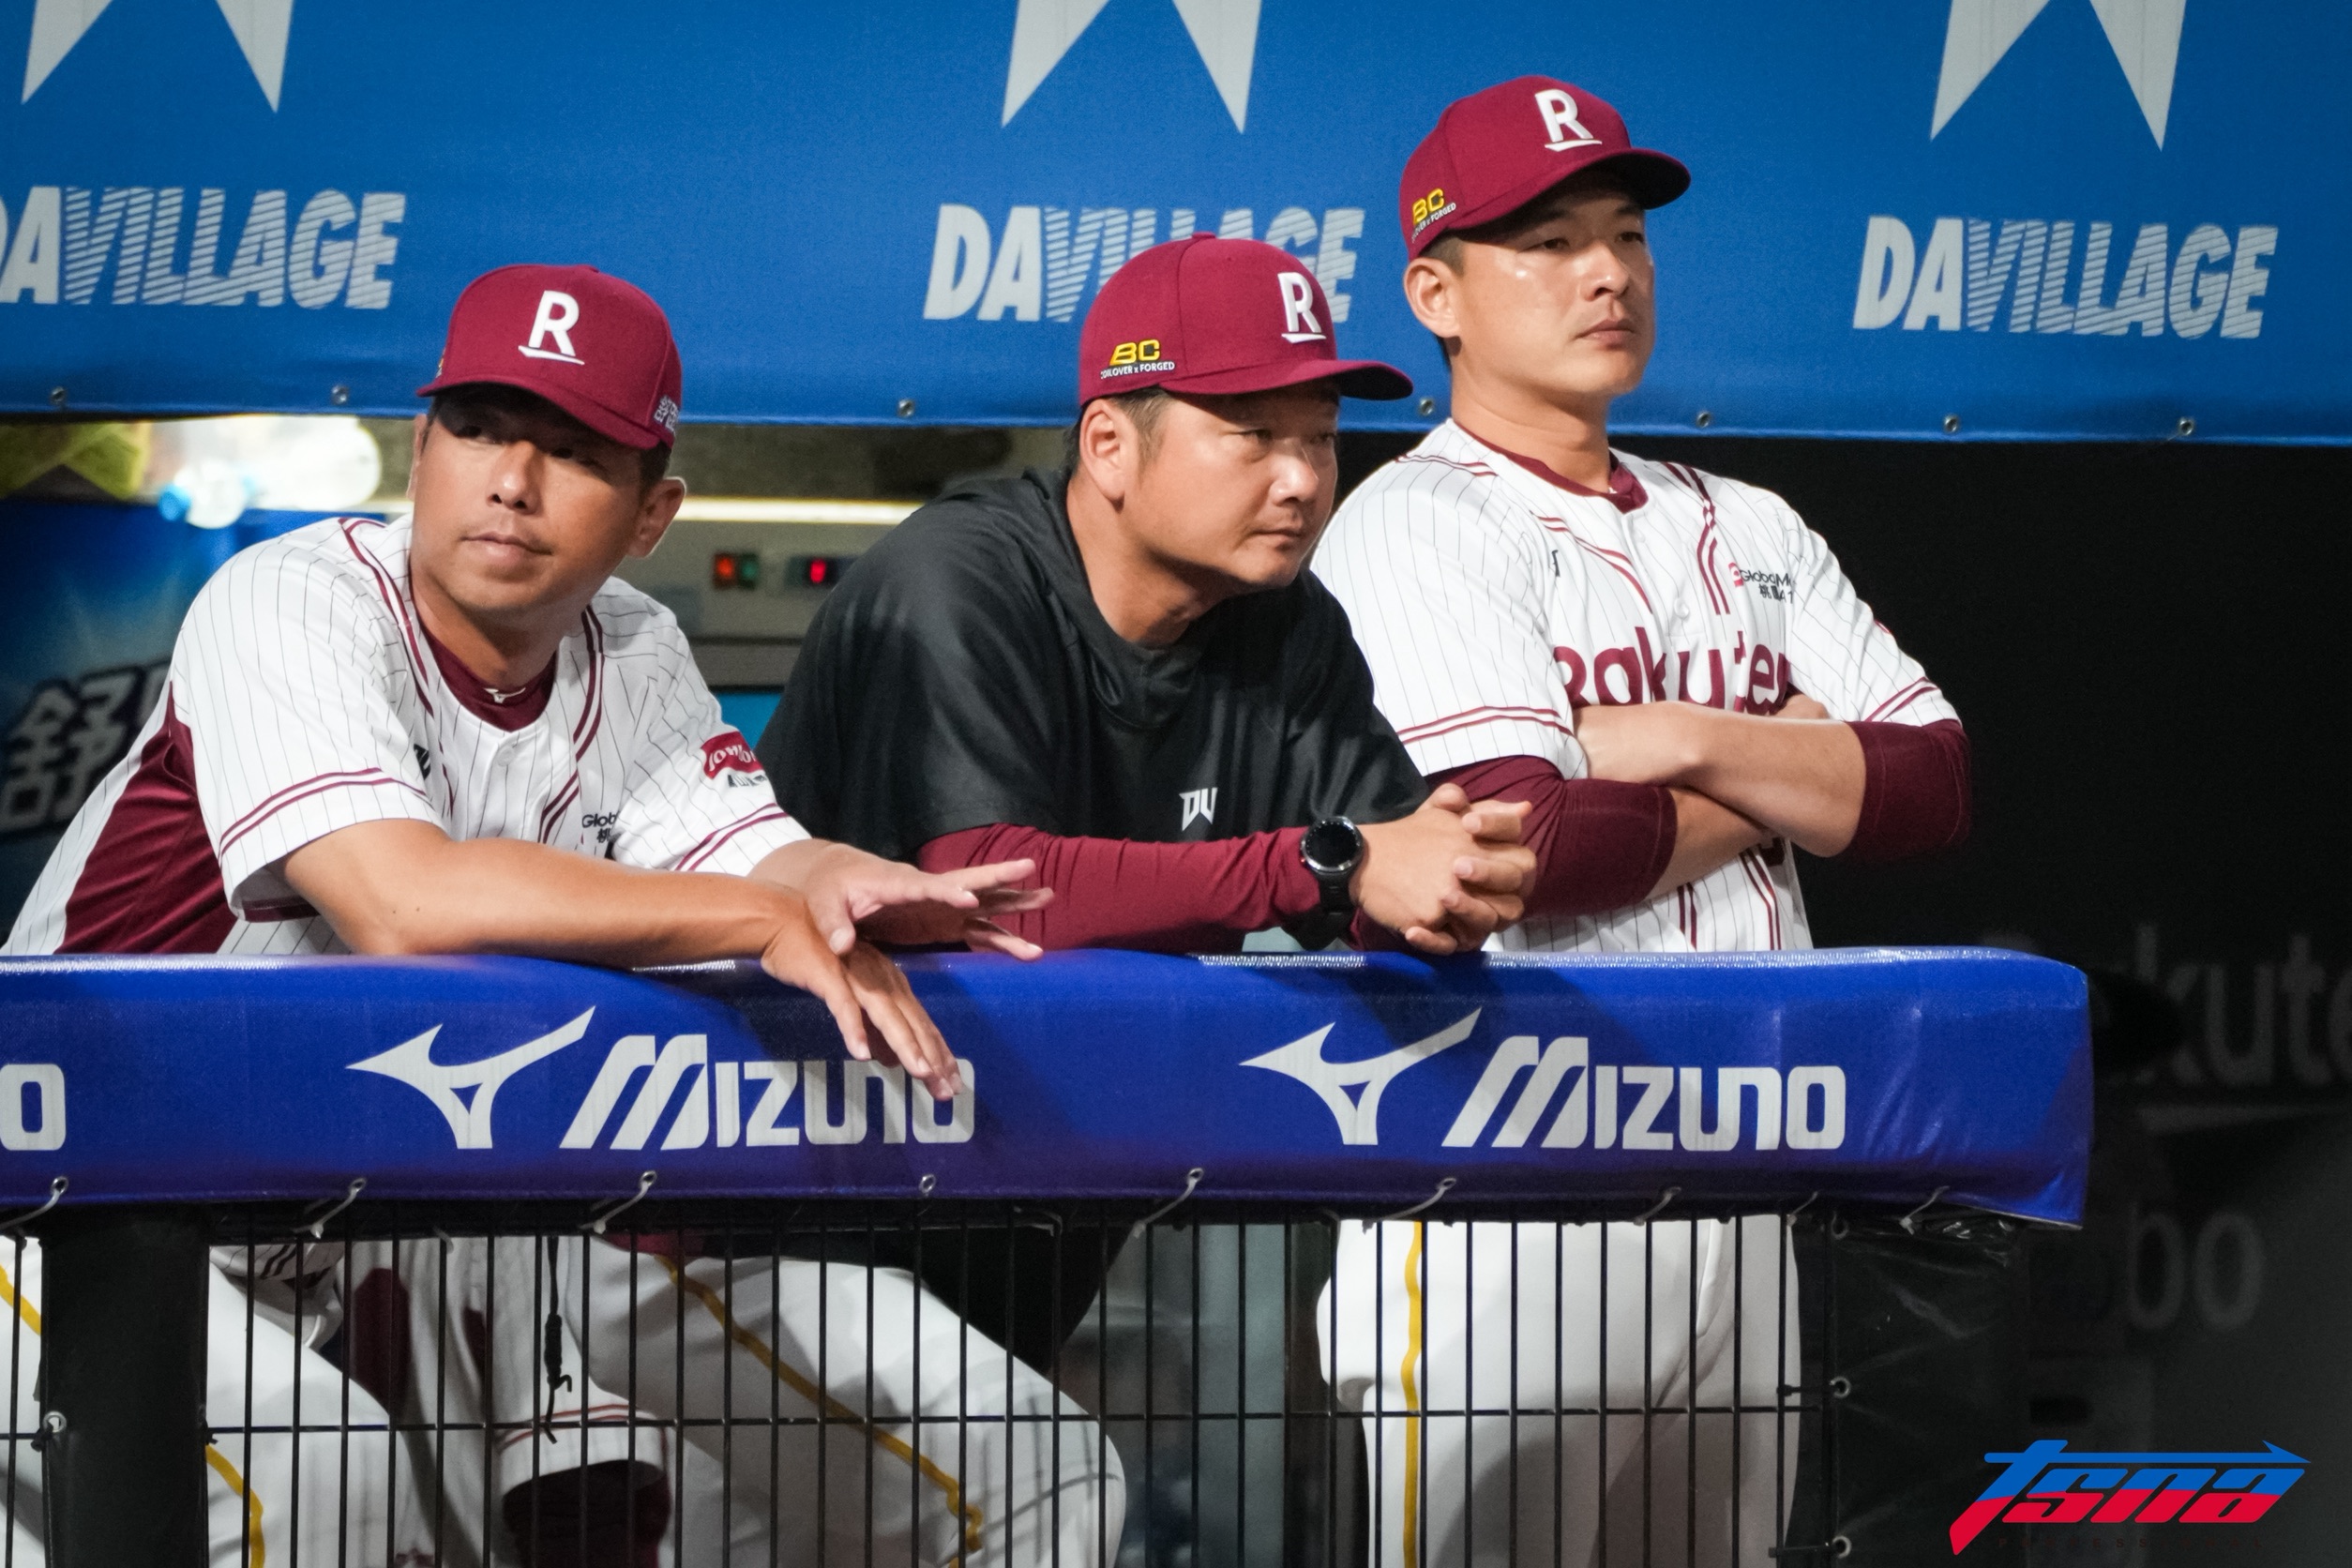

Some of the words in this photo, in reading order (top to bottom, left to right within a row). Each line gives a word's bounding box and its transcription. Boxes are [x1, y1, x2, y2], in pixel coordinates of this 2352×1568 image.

[1534, 88, 1594, 143] R
[1412, 188, 1444, 224] BC
[1430, 202, 1456, 222] FORGED
[0, 186, 406, 310] AVILLAGE
[1277, 272, 1322, 334] R
[1852, 214, 2280, 340] DAVILLAGE
[527, 290, 580, 356] R
[1109, 339, 1160, 366] BC
[1139, 360, 1175, 373] FORGED
